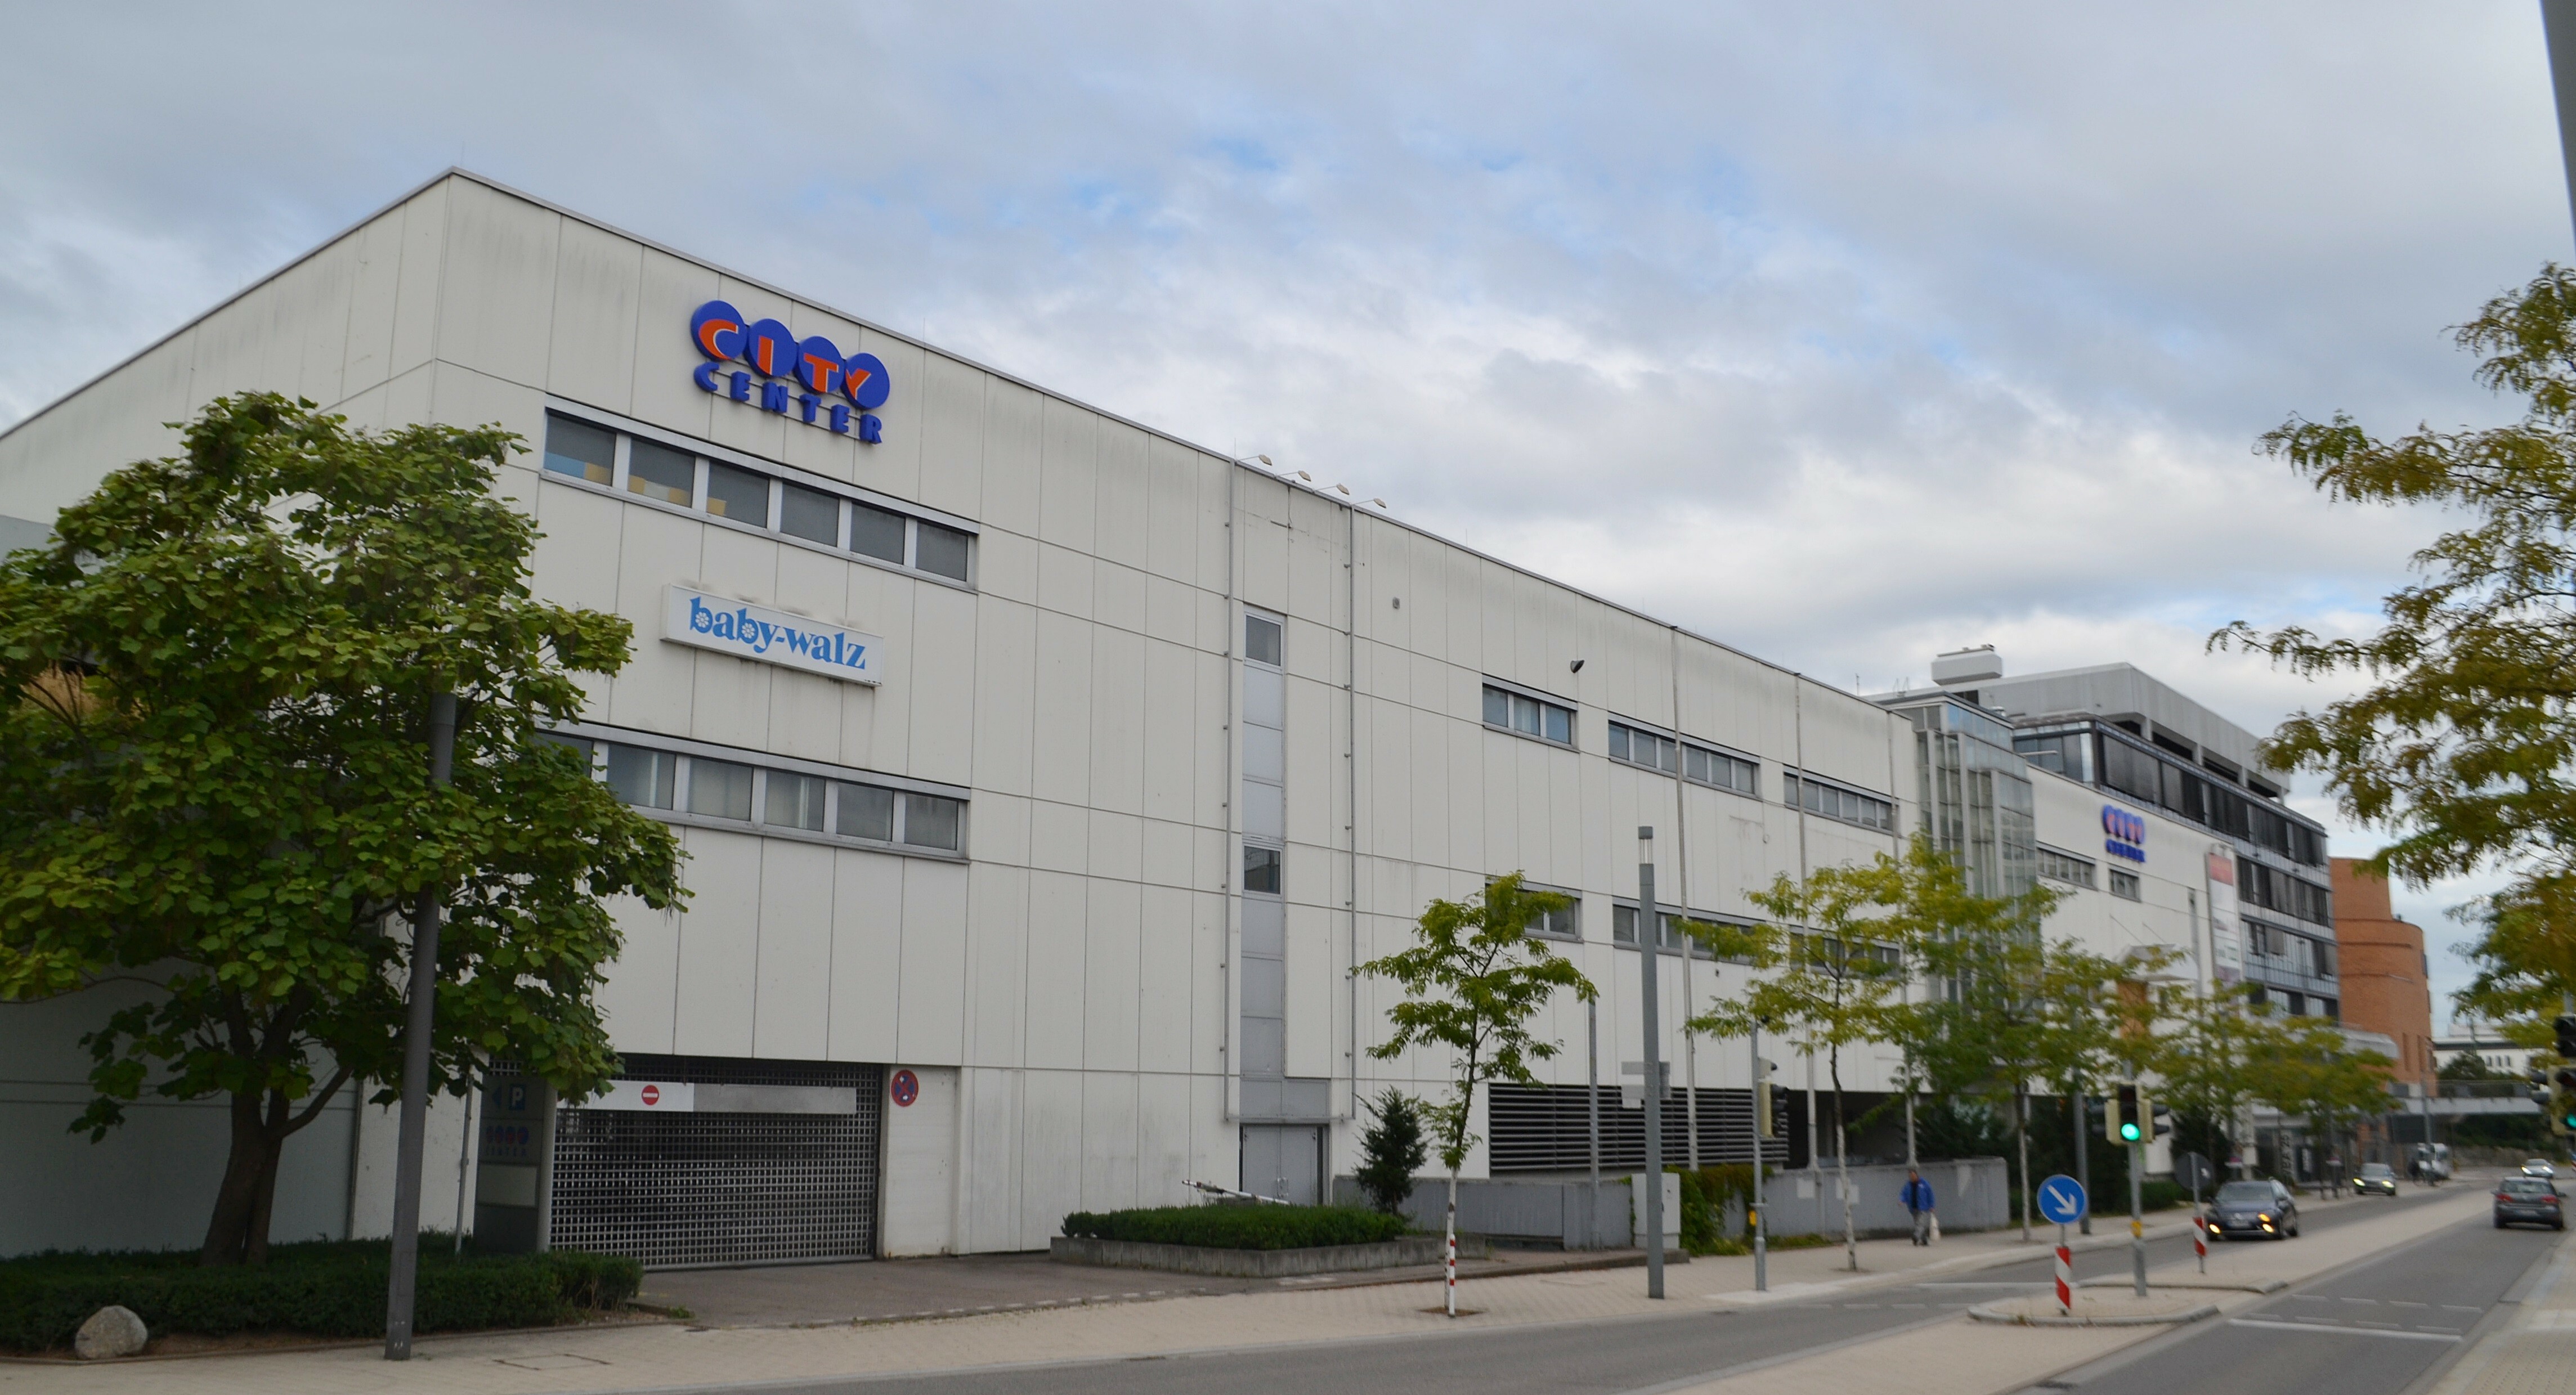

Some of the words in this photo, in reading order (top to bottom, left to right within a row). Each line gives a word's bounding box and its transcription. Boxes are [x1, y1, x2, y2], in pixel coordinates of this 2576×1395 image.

[696, 315, 874, 400] CITY
[693, 361, 882, 445] CENTER
[689, 596, 866, 670] baby-walz
[512, 1086, 523, 1107] P
